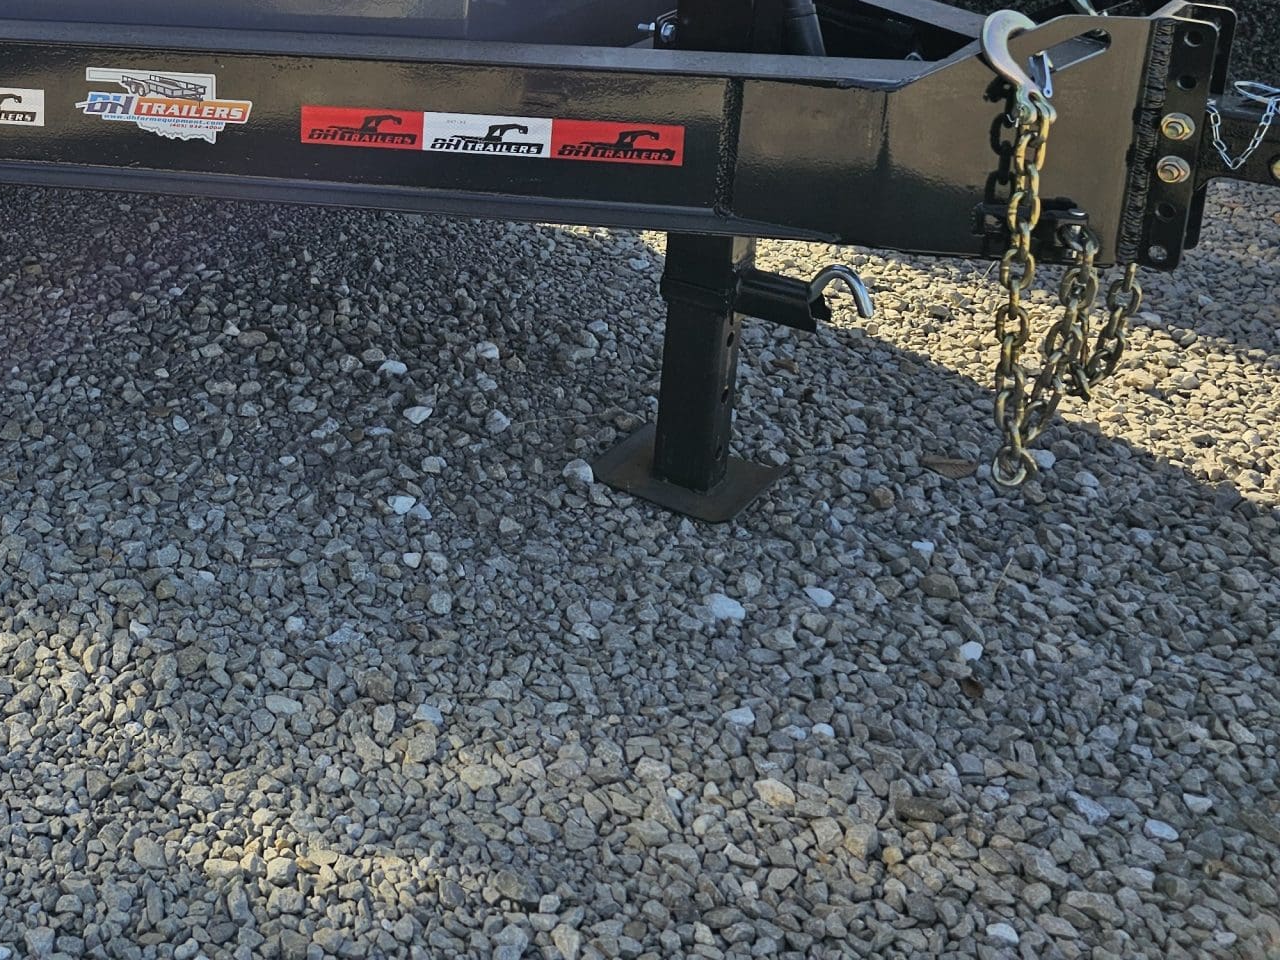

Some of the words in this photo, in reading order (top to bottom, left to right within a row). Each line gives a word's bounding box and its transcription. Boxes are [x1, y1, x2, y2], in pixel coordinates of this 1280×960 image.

[87, 93, 135, 115] DH
[140, 102, 244, 120] TRAILERS
[104, 114, 224, 127] www.dhfarmequipment.com
[308, 128, 337, 140] DH
[343, 133, 412, 145] TRAILERS
[430, 138, 461, 150] DH
[466, 142, 539, 154] TRAILERS
[558, 144, 590, 156] DH
[596, 148, 670, 161] TRAILERS
